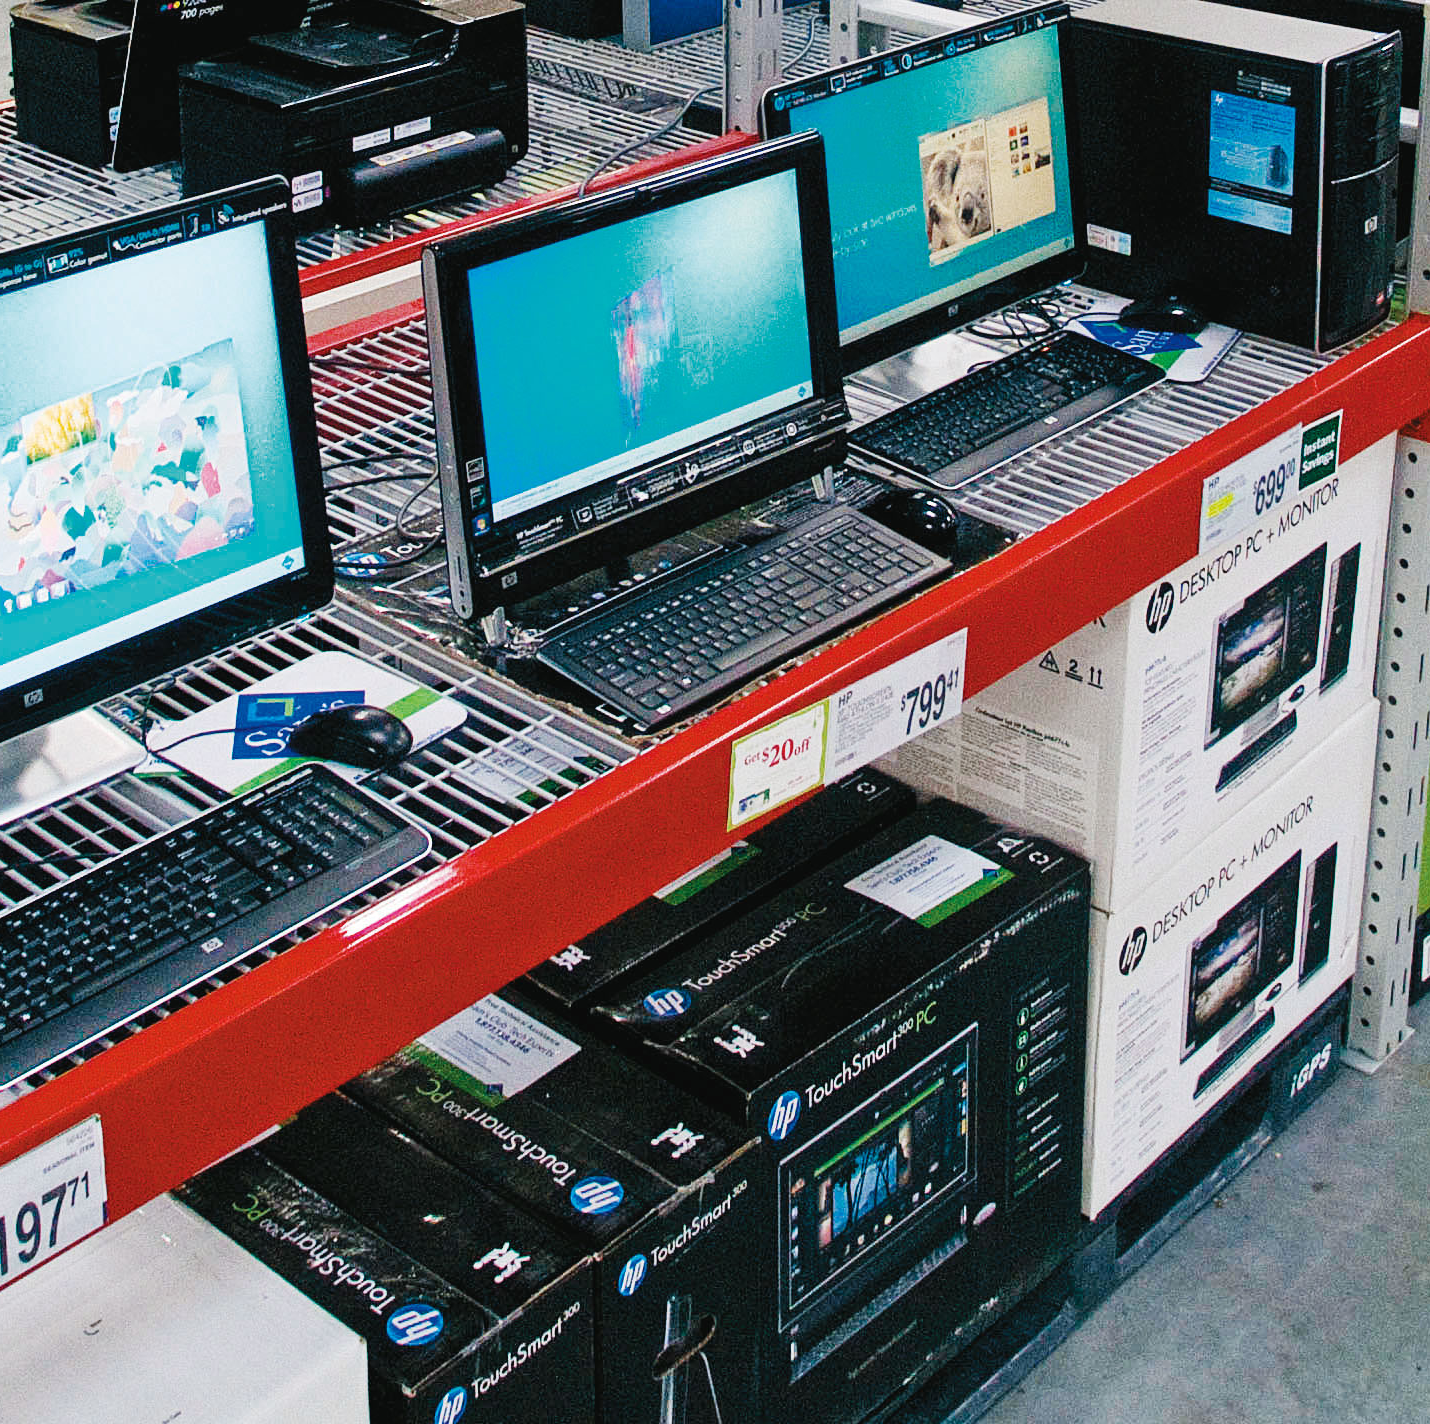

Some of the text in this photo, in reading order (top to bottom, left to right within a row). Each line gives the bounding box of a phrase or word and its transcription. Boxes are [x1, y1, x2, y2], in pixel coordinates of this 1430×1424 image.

[198, 1, 225, 19] pages
[1301, 450, 1335, 477] Savings
[1302, 433, 1336, 458] Instant
[1207, 476, 1220, 490] HP
[1145, 478, 1340, 634] hp DESKTOP PC MONITOR
[838, 690, 854, 709] HP
[744, 734, 812, 768] Get $20 off
[1118, 794, 1314, 976] hp DESKTOP PC MONITOR
[643, 987, 692, 1017] hp
[797, 902, 828, 923] PC
[415, 1076, 446, 1105] PC
[768, 1090, 801, 1141] hp
[915, 1000, 938, 1034] PC
[570, 1175, 625, 1215] hp
[618, 1253, 647, 1296] hp
[385, 1303, 445, 1346] hp
[433, 1384, 467, 1424] hp
